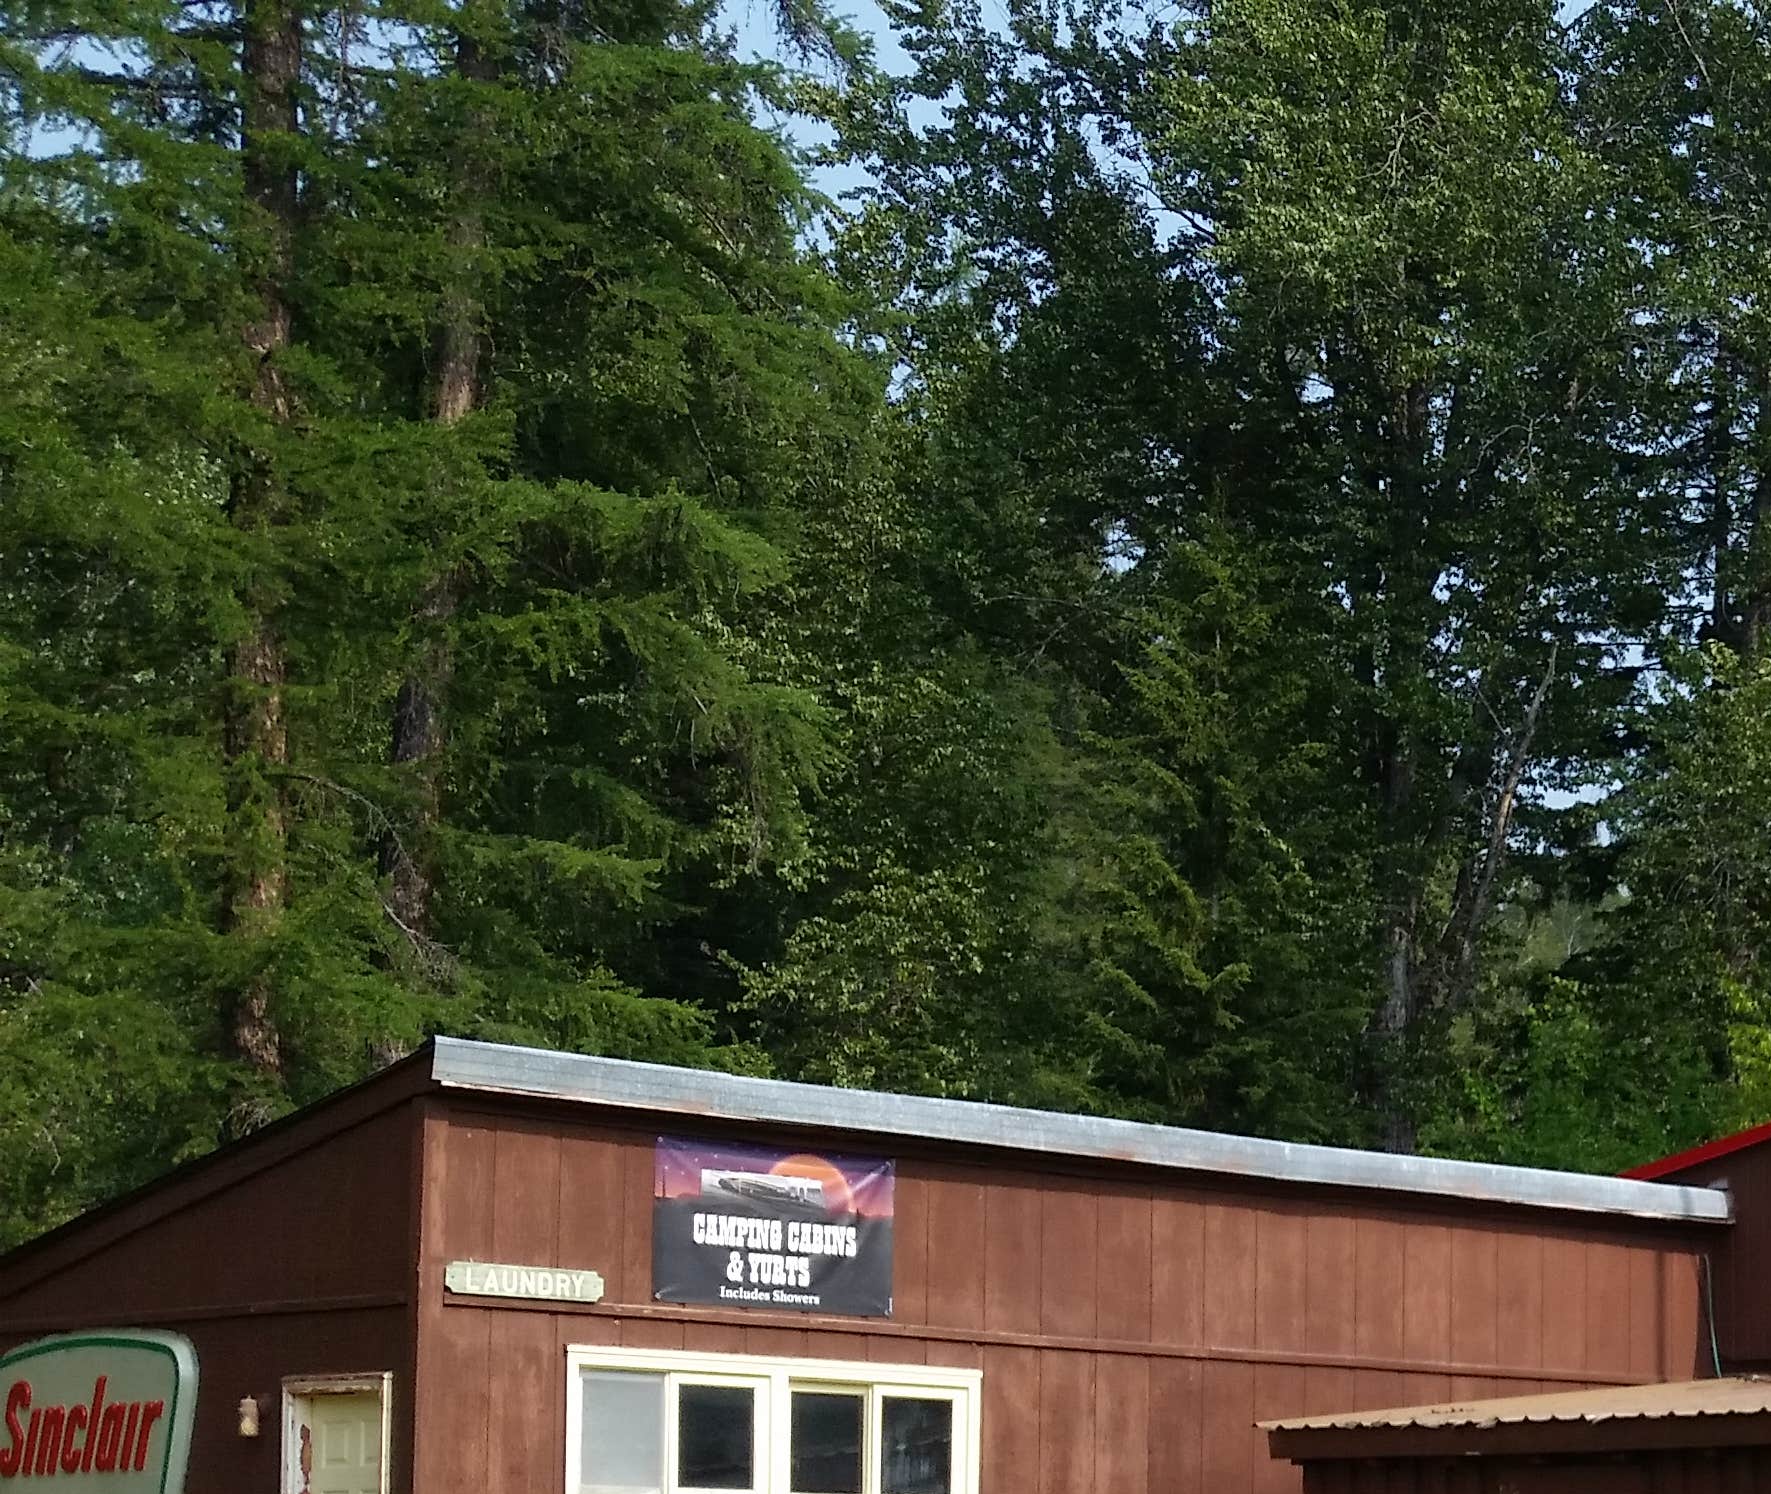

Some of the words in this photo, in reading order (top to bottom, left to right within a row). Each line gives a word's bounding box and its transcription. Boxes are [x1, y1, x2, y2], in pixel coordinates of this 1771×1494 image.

[693, 1212, 783, 1251] CAMPING
[787, 1221, 857, 1257] CABINS
[465, 1266, 585, 1298] LAUNDRY
[726, 1251, 744, 1282] &
[748, 1252, 811, 1287] YURTS
[719, 1285, 771, 1302] Includes
[772, 1290, 821, 1305] Showers
[0, 1375, 164, 1478] Sinclair
